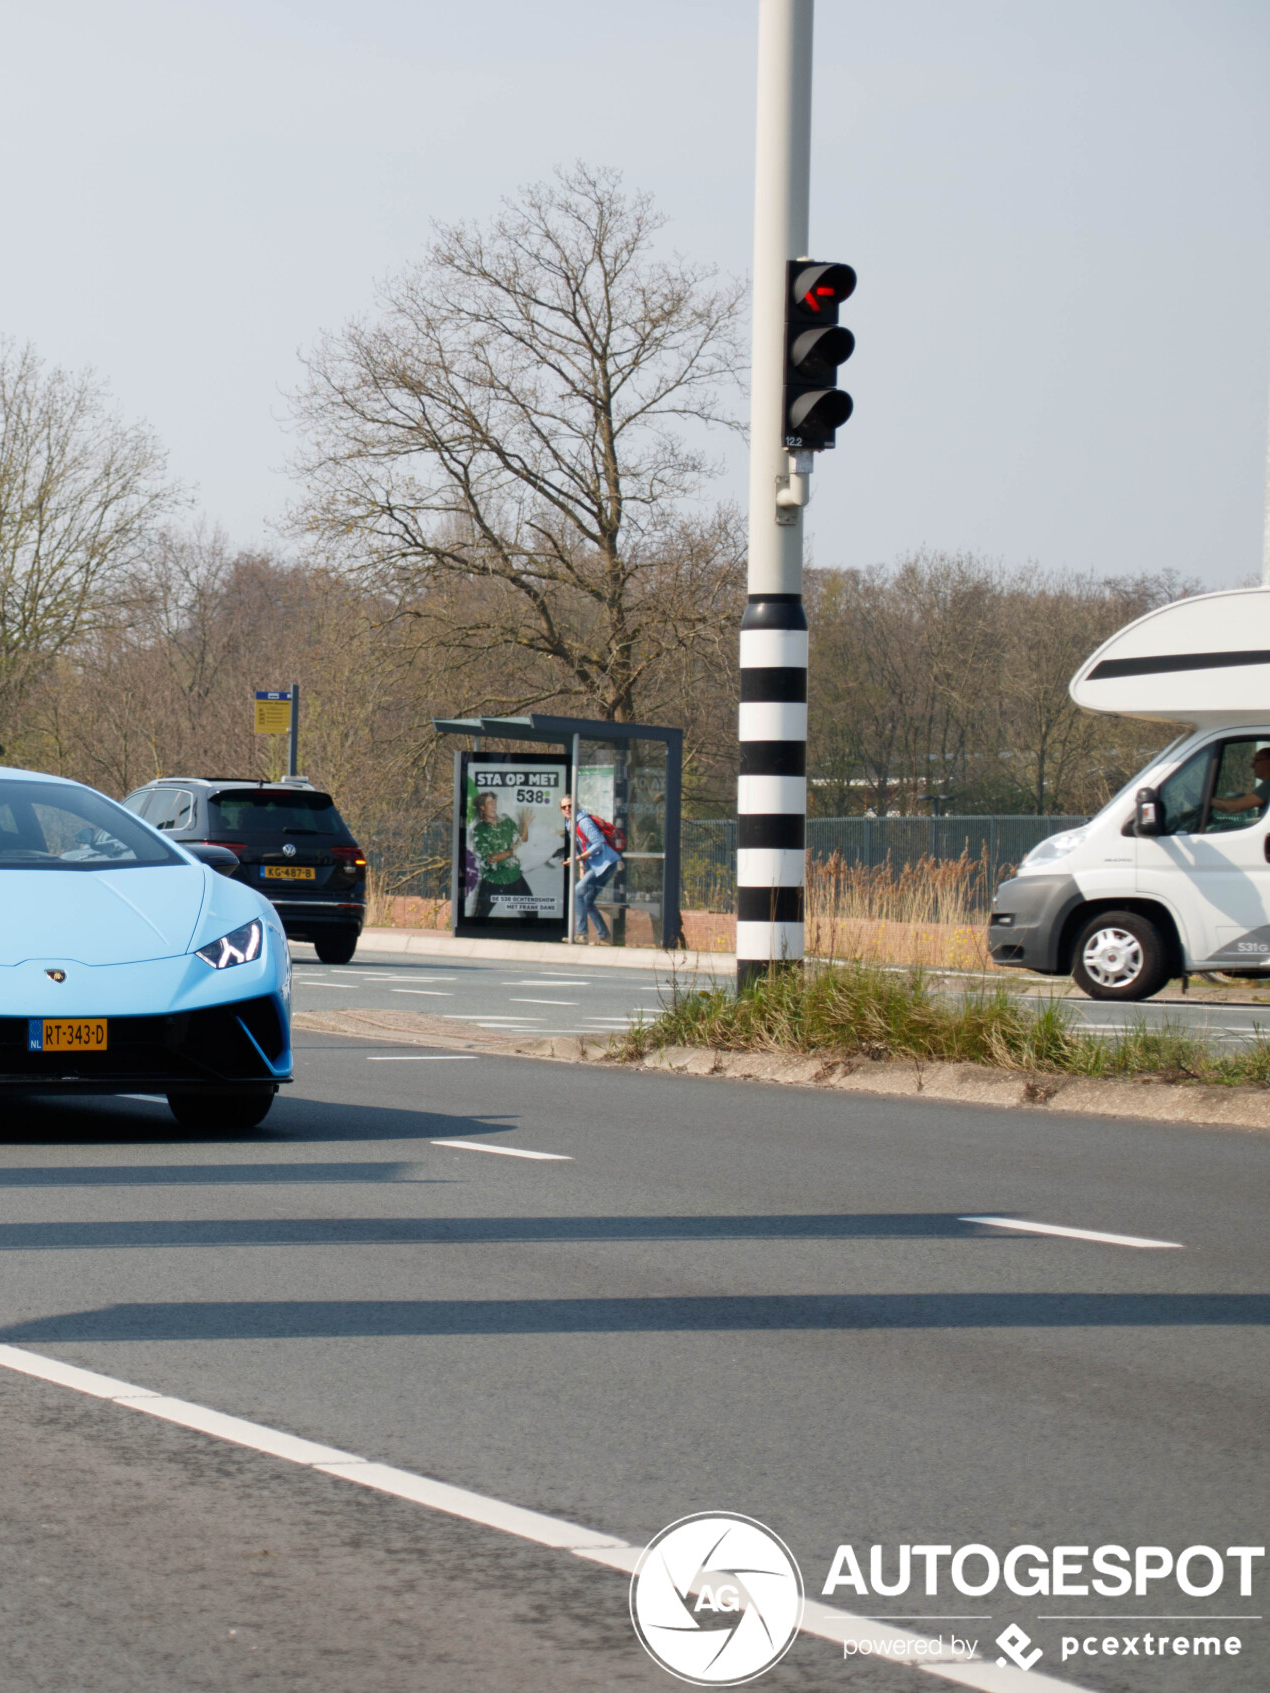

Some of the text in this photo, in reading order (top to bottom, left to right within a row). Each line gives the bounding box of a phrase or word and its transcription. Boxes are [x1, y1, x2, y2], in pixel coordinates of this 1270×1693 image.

[477, 773, 557, 786] STA OP MET
[30, 1025, 104, 1048] NL RT-343-D
